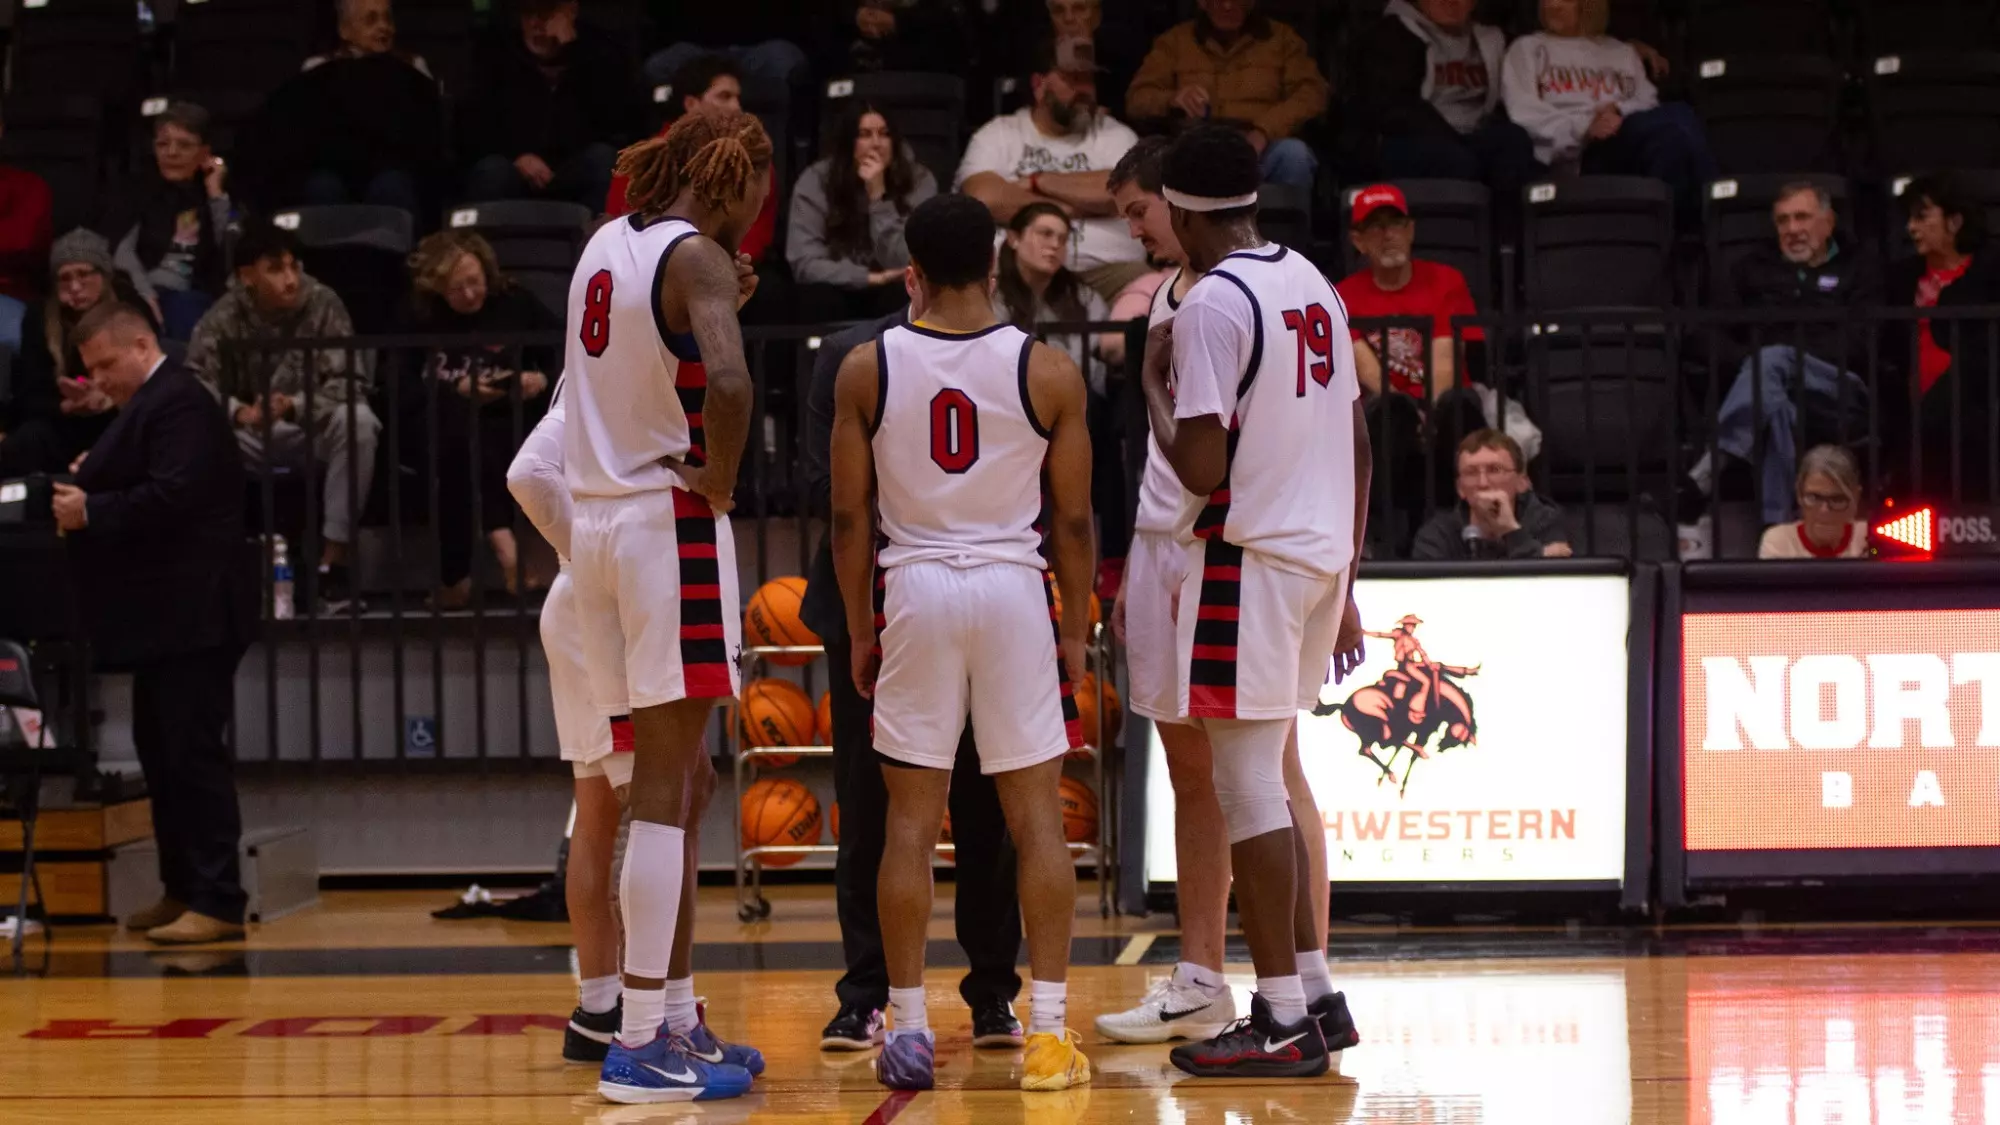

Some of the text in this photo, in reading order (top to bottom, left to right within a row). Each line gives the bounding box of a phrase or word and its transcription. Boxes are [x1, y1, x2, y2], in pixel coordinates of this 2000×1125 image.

[580, 269, 614, 358] 8
[930, 388, 979, 474] 0
[1938, 517, 1996, 543] POSS.
